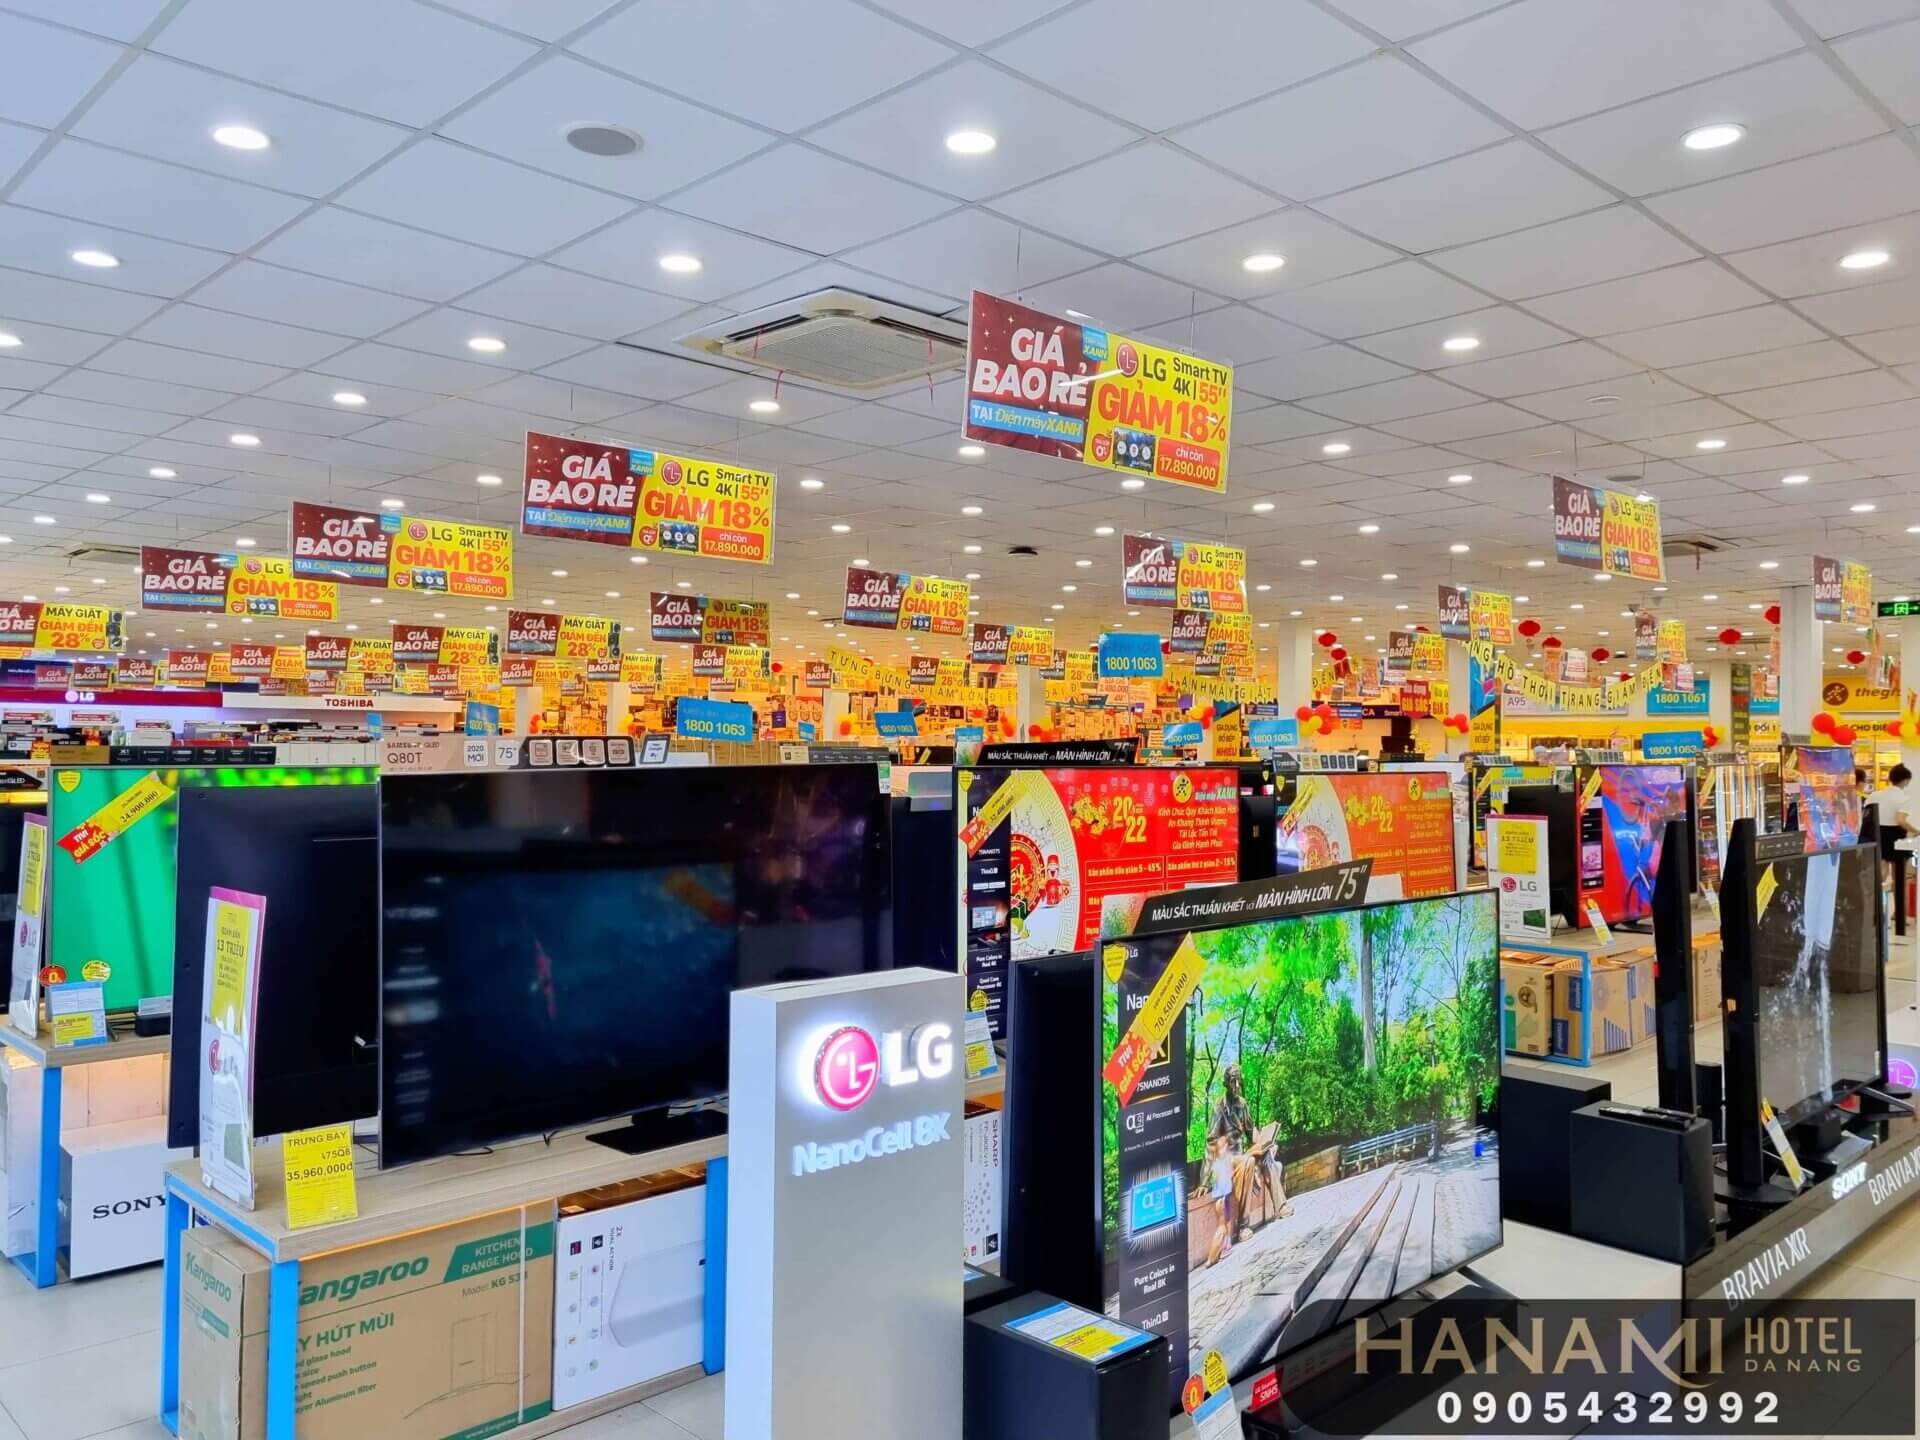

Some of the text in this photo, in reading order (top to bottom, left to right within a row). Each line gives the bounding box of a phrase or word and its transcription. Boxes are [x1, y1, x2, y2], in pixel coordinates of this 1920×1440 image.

[1011, 326, 1065, 366] GIÁ
[1143, 354, 1227, 386] LG Smart TV
[973, 359, 1089, 407] BAO RẺ
[1173, 378, 1190, 397] 4K
[973, 404, 993, 427] TẠI
[1098, 379, 1226, 443] GIẢM 18%
[561, 451, 613, 481] GIÁ
[1160, 456, 1216, 481] 17.890.000
[687, 467, 770, 488] LG Smart TV
[528, 476, 636, 508] BAO RẺ
[715, 483, 732, 498] 4K
[643, 486, 769, 530] GIẢM 18%
[1568, 489, 1588, 513] GIÁ
[1620, 502, 1632, 517] LG
[1556, 510, 1601, 537] BAO RẺ
[432, 526, 508, 542] LG Smart TV
[1605, 519, 1635, 548] GIẢM
[296, 535, 387, 558] BAO RẺ
[459, 538, 474, 549] 4K
[704, 541, 760, 557] 17.890.000
[168, 556, 207, 574] GIÁ
[396, 542, 510, 574] GIẢM 18%
[1200, 551, 1212, 563] LG
[265, 562, 284, 575] LG
[1159, 560, 1176, 583] RẺ
[1181, 564, 1216, 589] GIẢM
[144, 570, 225, 590] BAO RẺ
[234, 575, 336, 600] GIẢM 18%
[864, 576, 889, 592] GIÁ
[926, 582, 938, 594] LG
[666, 599, 690, 613] GIÁ
[724, 602, 737, 612] LG
[847, 588, 901, 609] BAO RẺ
[904, 594, 940, 614] GIẢM
[46, 606, 73, 617] MÁY
[652, 613, 687, 626] BAO
[1184, 612, 1200, 625] GIÁ
[524, 616, 546, 630] GIÁ
[564, 617, 583, 628] MÁY
[705, 612, 741, 630] GIẢM
[407, 629, 429, 641] GIÁ
[446, 629, 466, 639] MÁY
[510, 626, 557, 640] BAO RẺ
[984, 629, 1000, 640] GIÁ
[1173, 626, 1193, 638] BAO
[243, 647, 262, 658] GIÁ
[318, 637, 337, 650] GIÁ
[353, 638, 372, 649] MÁY
[394, 637, 439, 650] BAO RẺ
[974, 640, 994, 651] BAO
[232, 657, 256, 667] BAO
[588, 663, 609, 672] BAO
[1105, 656, 1157, 671] 1800 1063
[80, 692, 96, 702] LG
[325, 698, 374, 708] TOSHIBA
[1507, 696, 1526, 706] A95
[1562, 691, 1600, 706] TRANG
[1655, 693, 1679, 704] 1800
[684, 718, 746, 736] 1800 1063
[387, 752, 422, 764] Q80T
[988, 751, 1001, 760] MÀU
[1056, 749, 1075, 761] MÀN
[1076, 749, 1094, 761] HÌNH
[1125, 815, 1146, 843] 22
[1380, 812, 1393, 833] 22
[88, 828, 106, 850] SỐC
[1520, 881, 1537, 892] LG
[1152, 905, 1173, 921] MÀU
[1174, 904, 1190, 918] SẮC
[1192, 901, 1222, 916] THUẦN
[1223, 898, 1246, 914] KHIẾT
[1256, 887, 1284, 909] MÀN
[1285, 884, 1312, 904] HÌNH
[1312, 883, 1333, 901] LỚN
[882, 1022, 953, 1088] LG
[1133, 1044, 1151, 1074] SỐC
[326, 1131, 346, 1142] BAY
[791, 1111, 952, 1177] NanoCell 8K
[1832, 1161, 1868, 1200] SONY
[1867, 1156, 1916, 1206] BRAVIA
[93, 1194, 166, 1220] SONY
[475, 1238, 521, 1257] KITCHEN
[462, 1256, 500, 1274] RANGE
[1721, 1226, 1811, 1312] BRAVIA XR
[186, 1251, 231, 1303] Kangaroo
[491, 1275, 506, 1289] KG
[1134, 1263, 1176, 1288] Pure Colors in
[1143, 1281, 1157, 1294] Real
[316, 1312, 394, 1347] HÚT MÙI
[1142, 1313, 1162, 1331] ThinQ
[330, 1346, 352, 1358] hood
[301, 1360, 377, 1390] speed push button
[315, 1382, 377, 1408] Aluminum filter
